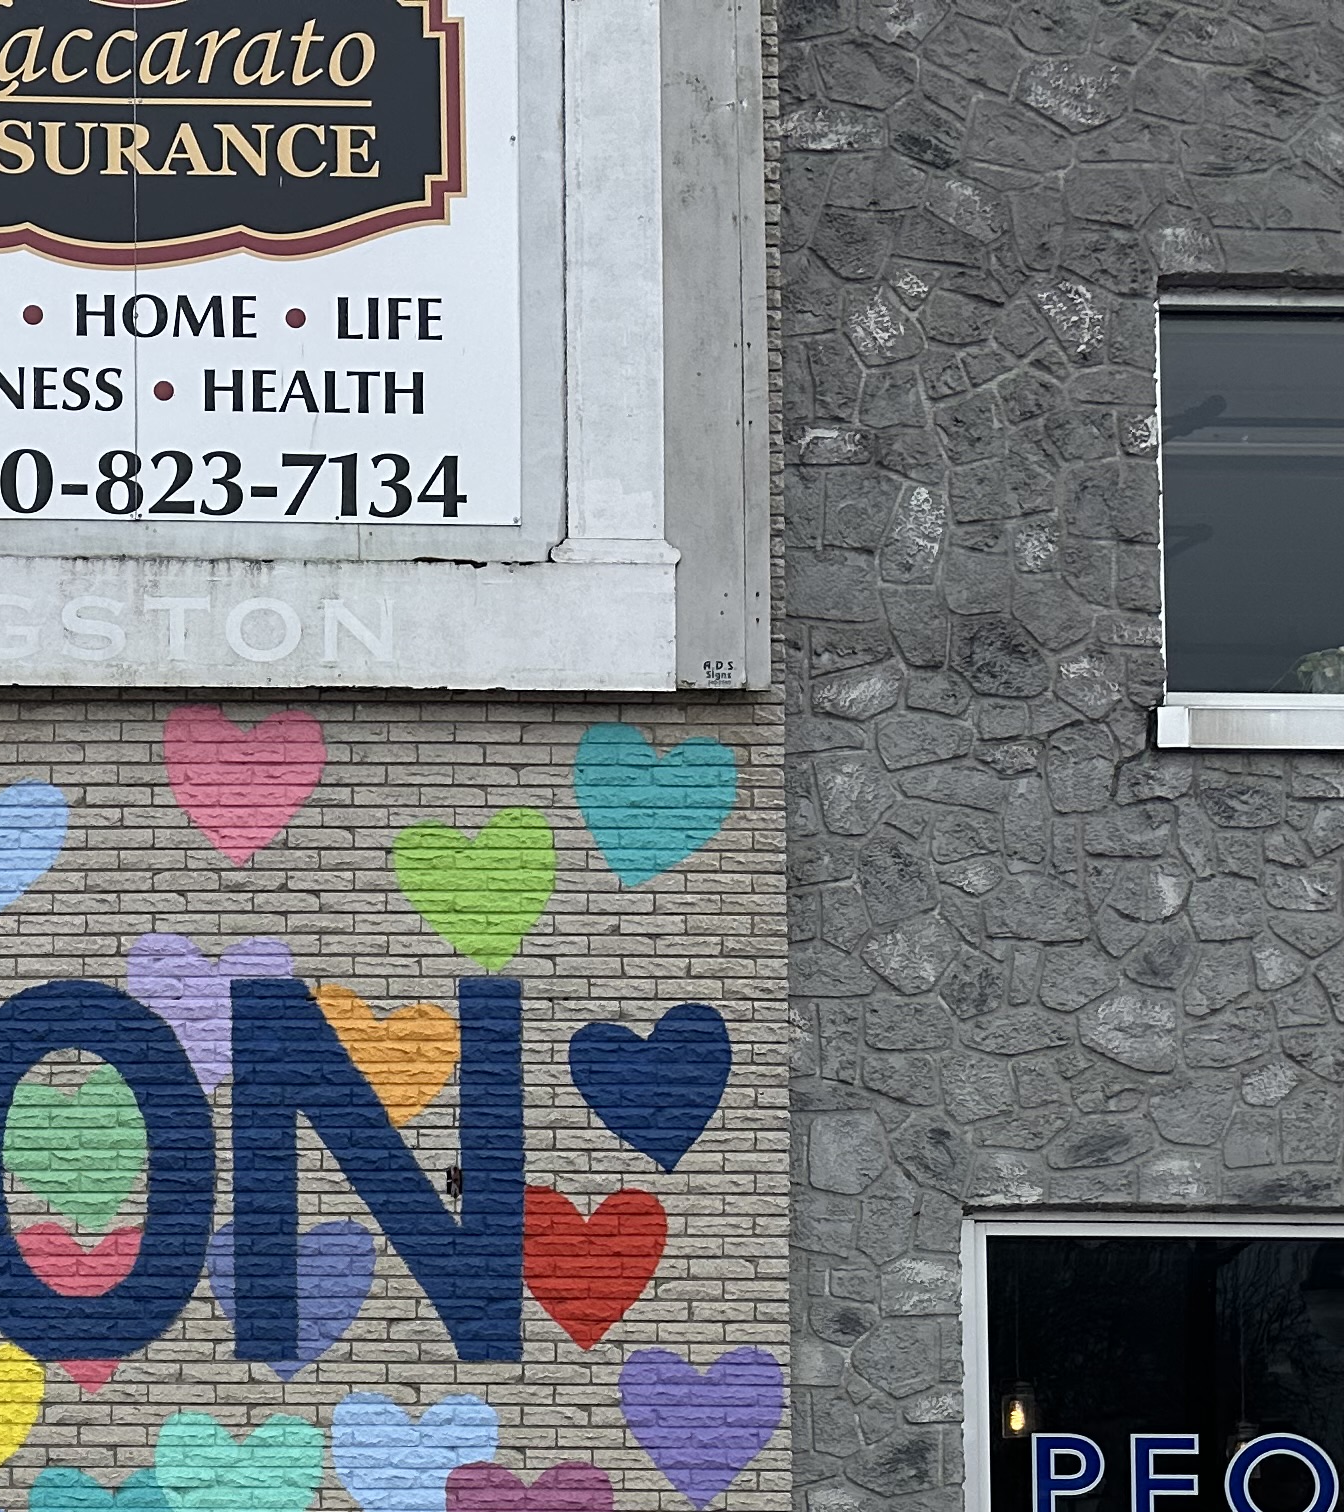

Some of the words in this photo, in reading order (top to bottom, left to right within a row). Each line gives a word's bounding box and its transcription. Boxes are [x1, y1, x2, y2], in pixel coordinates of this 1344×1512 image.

[75, 293, 257, 338] HOME
[337, 296, 443, 341] LIFE
[204, 369, 424, 415] HEALTH
